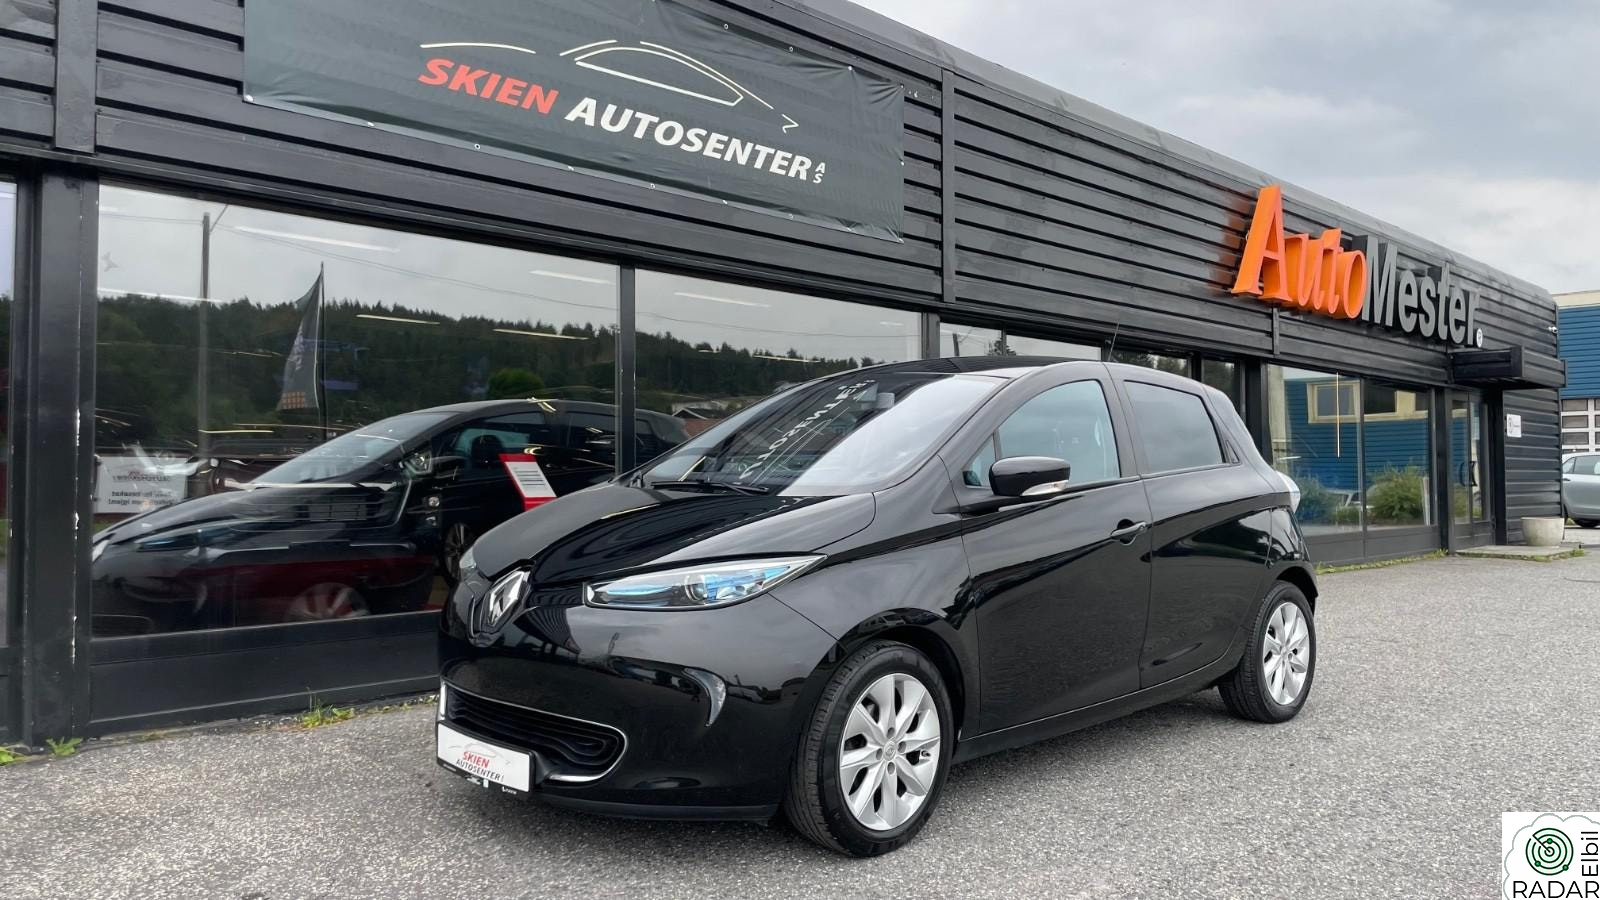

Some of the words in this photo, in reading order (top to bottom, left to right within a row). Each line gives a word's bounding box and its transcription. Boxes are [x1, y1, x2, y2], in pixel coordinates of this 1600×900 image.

[418, 58, 559, 115] SKIEN
[564, 96, 813, 181] AUTOSENTER
[456, 759, 501, 781] AUTOSENTER
[463, 751, 490, 769] SKIEN
